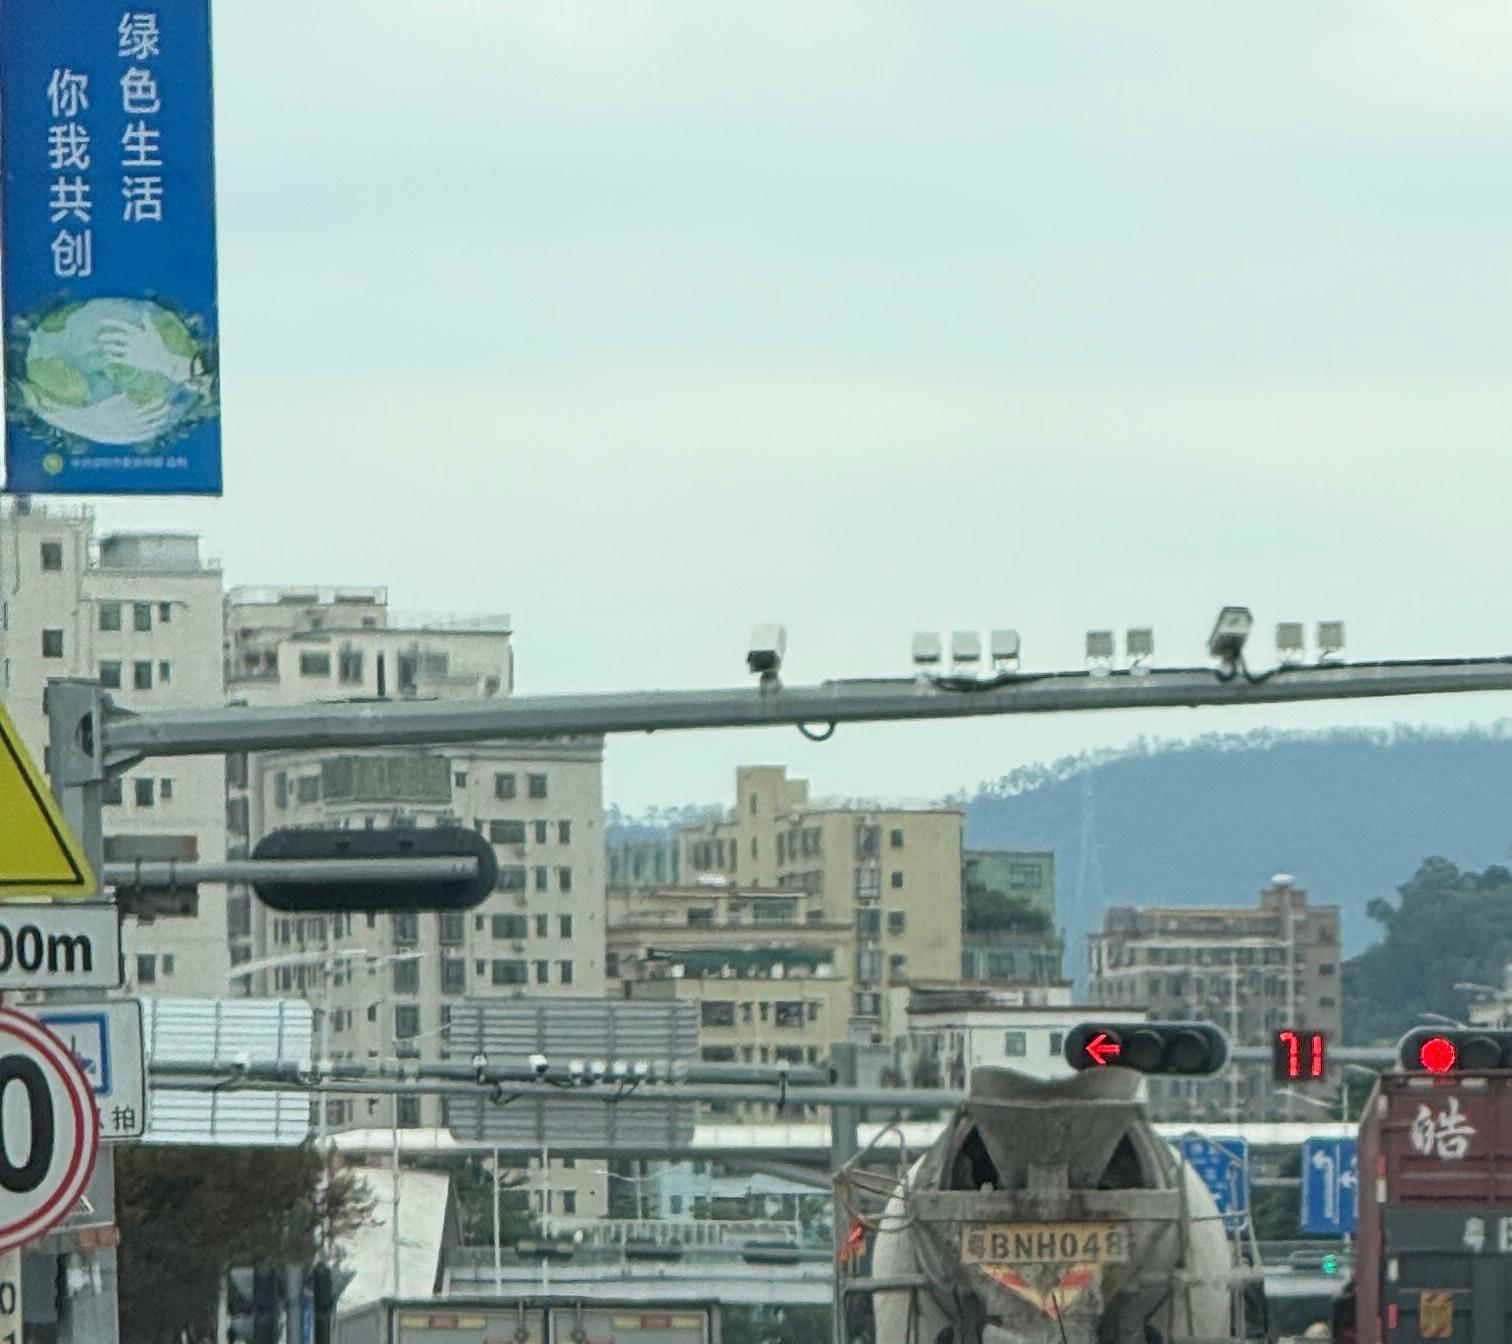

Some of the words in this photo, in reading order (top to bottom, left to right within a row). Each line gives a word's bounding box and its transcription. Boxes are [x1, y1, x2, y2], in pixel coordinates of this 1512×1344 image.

[47, 68, 92, 278] 你我共创
[117, 12, 163, 222] 绿色生活
[100, 1106, 136, 1131] 拍
[1278, 1031, 1323, 1078] 71
